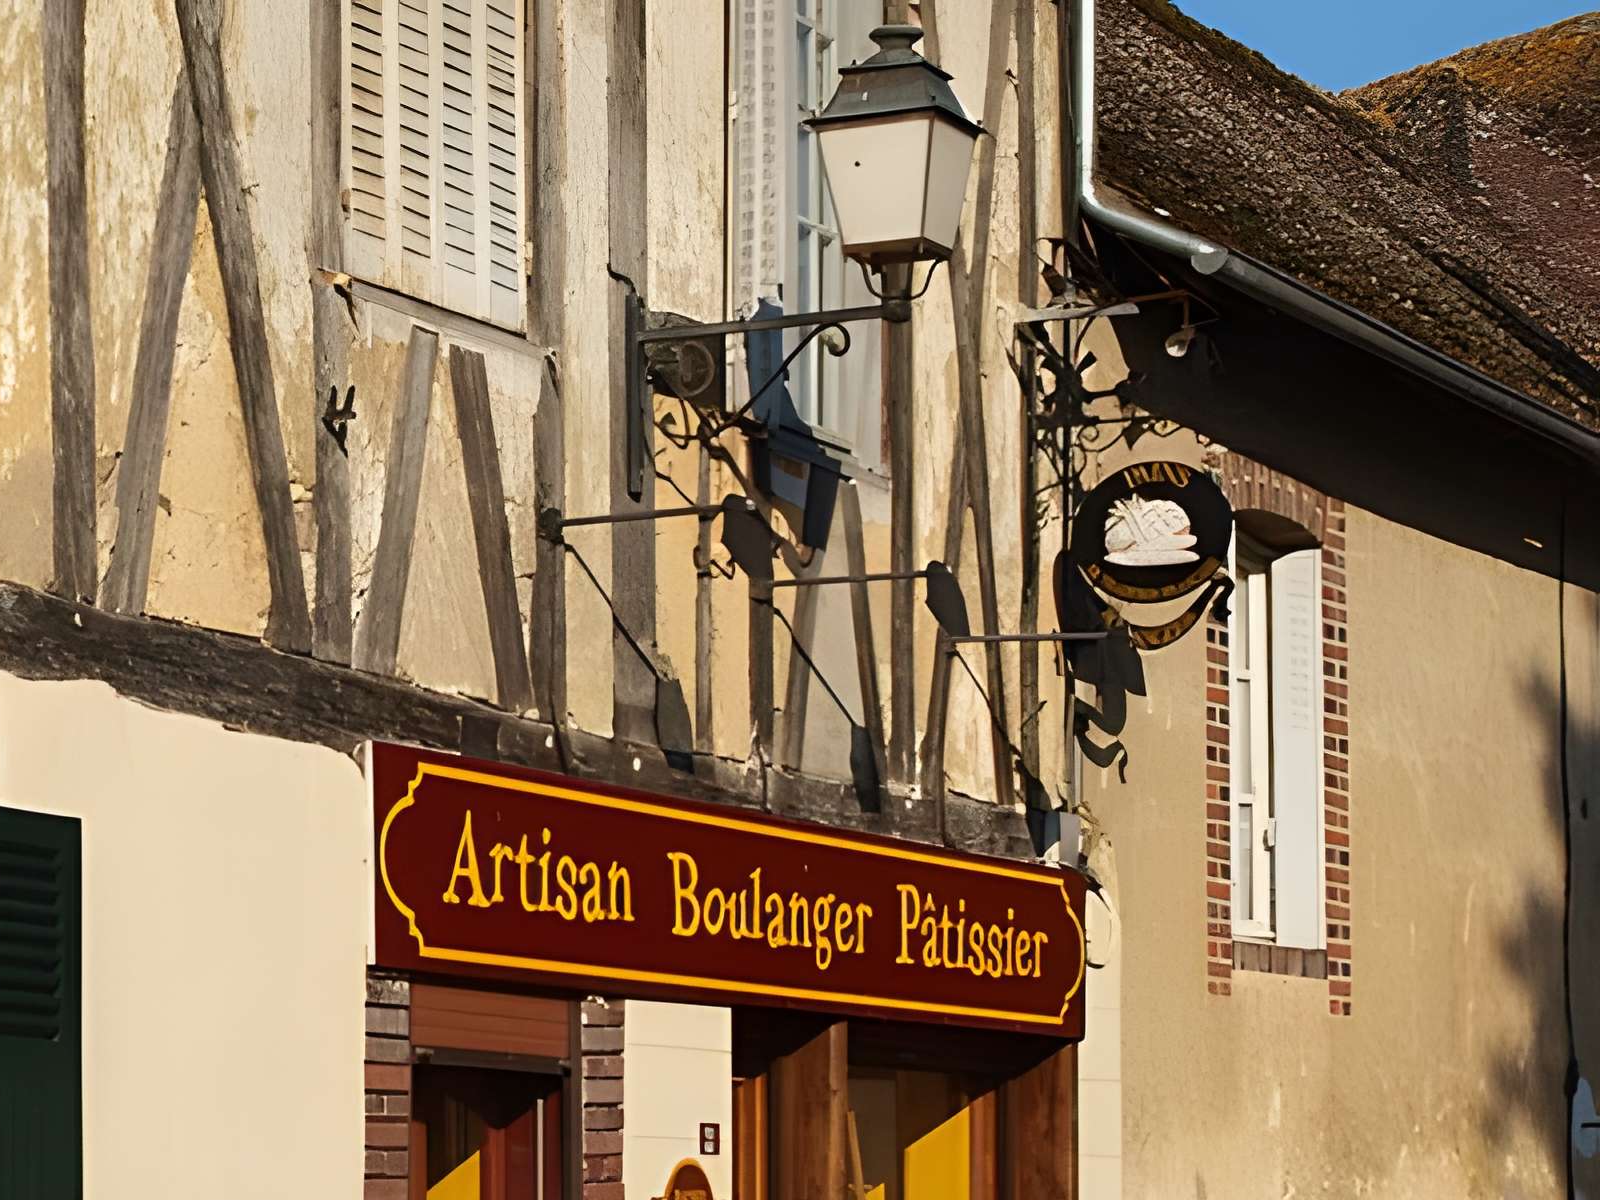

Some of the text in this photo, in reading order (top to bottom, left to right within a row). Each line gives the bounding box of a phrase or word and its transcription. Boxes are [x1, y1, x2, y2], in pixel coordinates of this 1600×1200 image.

[442, 809, 1049, 978] Artisan Boulanger Pâtissier
